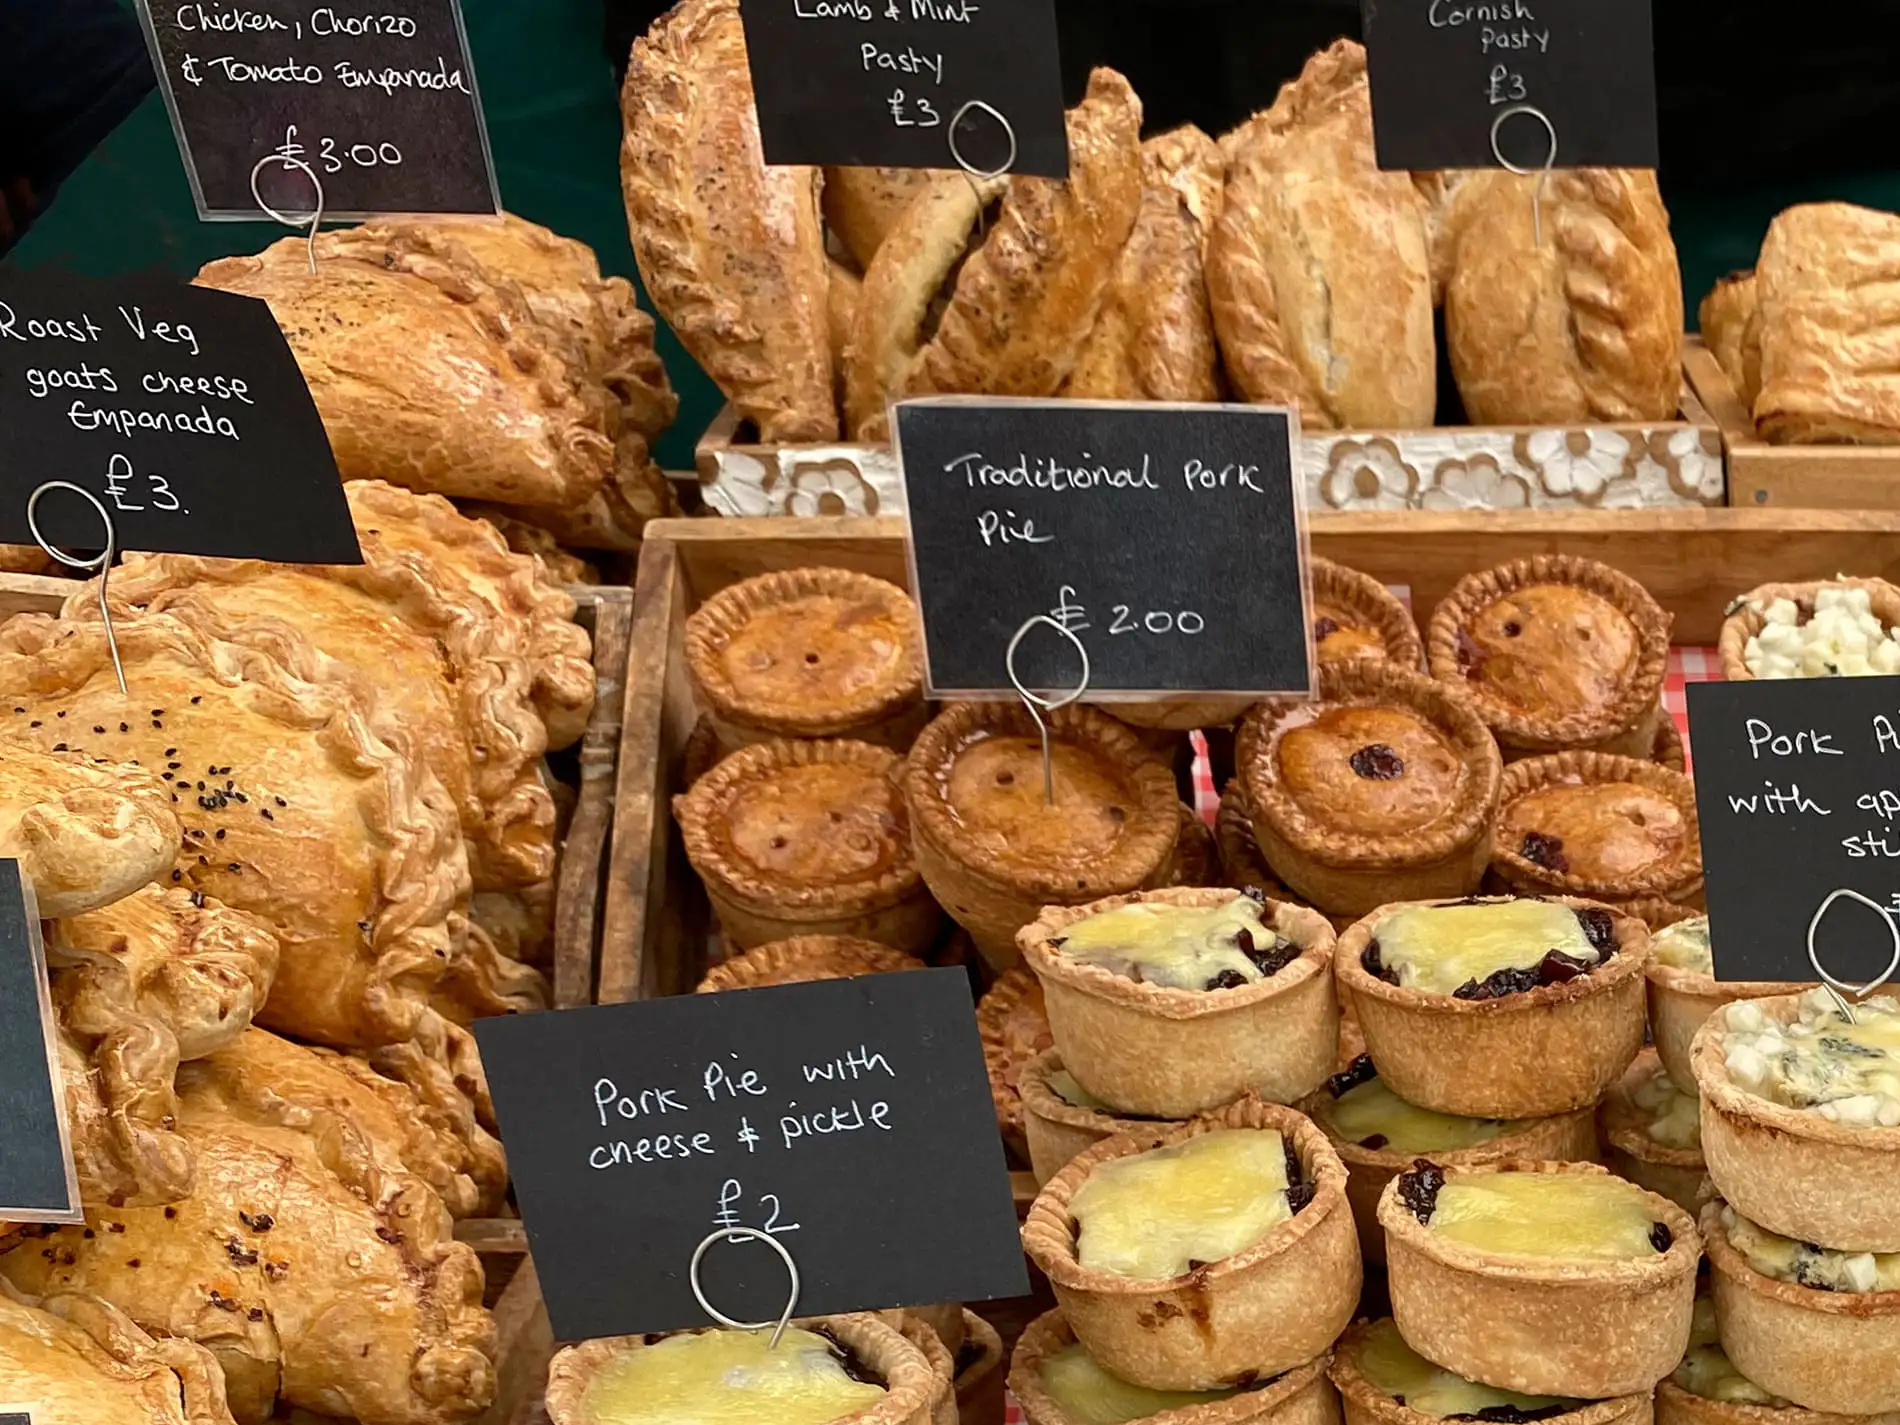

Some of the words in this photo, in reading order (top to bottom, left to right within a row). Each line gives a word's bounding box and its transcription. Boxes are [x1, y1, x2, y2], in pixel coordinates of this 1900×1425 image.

[311, 8, 417, 38] Chorizo
[795, 0, 873, 22] Lamb
[911, 0, 980, 24] Mint
[1428, 0, 1535, 27] Cornish
[181, 53, 203, 86] &
[207, 56, 323, 84] Tomato
[334, 57, 472, 96] Empanada
[860, 43, 943, 85] Pasty
[0, 303, 102, 342] Roast
[118, 306, 200, 355] Veg
[26, 362, 119, 398] goats
[142, 369, 254, 405] cheese
[68, 400, 240, 441] Empanada
[944, 452, 1160, 492] Traditional
[1184, 458, 1264, 494] Pork
[977, 510, 1055, 546] Pie
[1746, 718, 1844, 760] Pork
[1729, 780, 1832, 816] with
[592, 1077, 688, 1127] Pork
[702, 1052, 768, 1103] Pie
[802, 1044, 896, 1085] with
[588, 1130, 716, 1171] cheese
[779, 1100, 893, 1151] pickle
